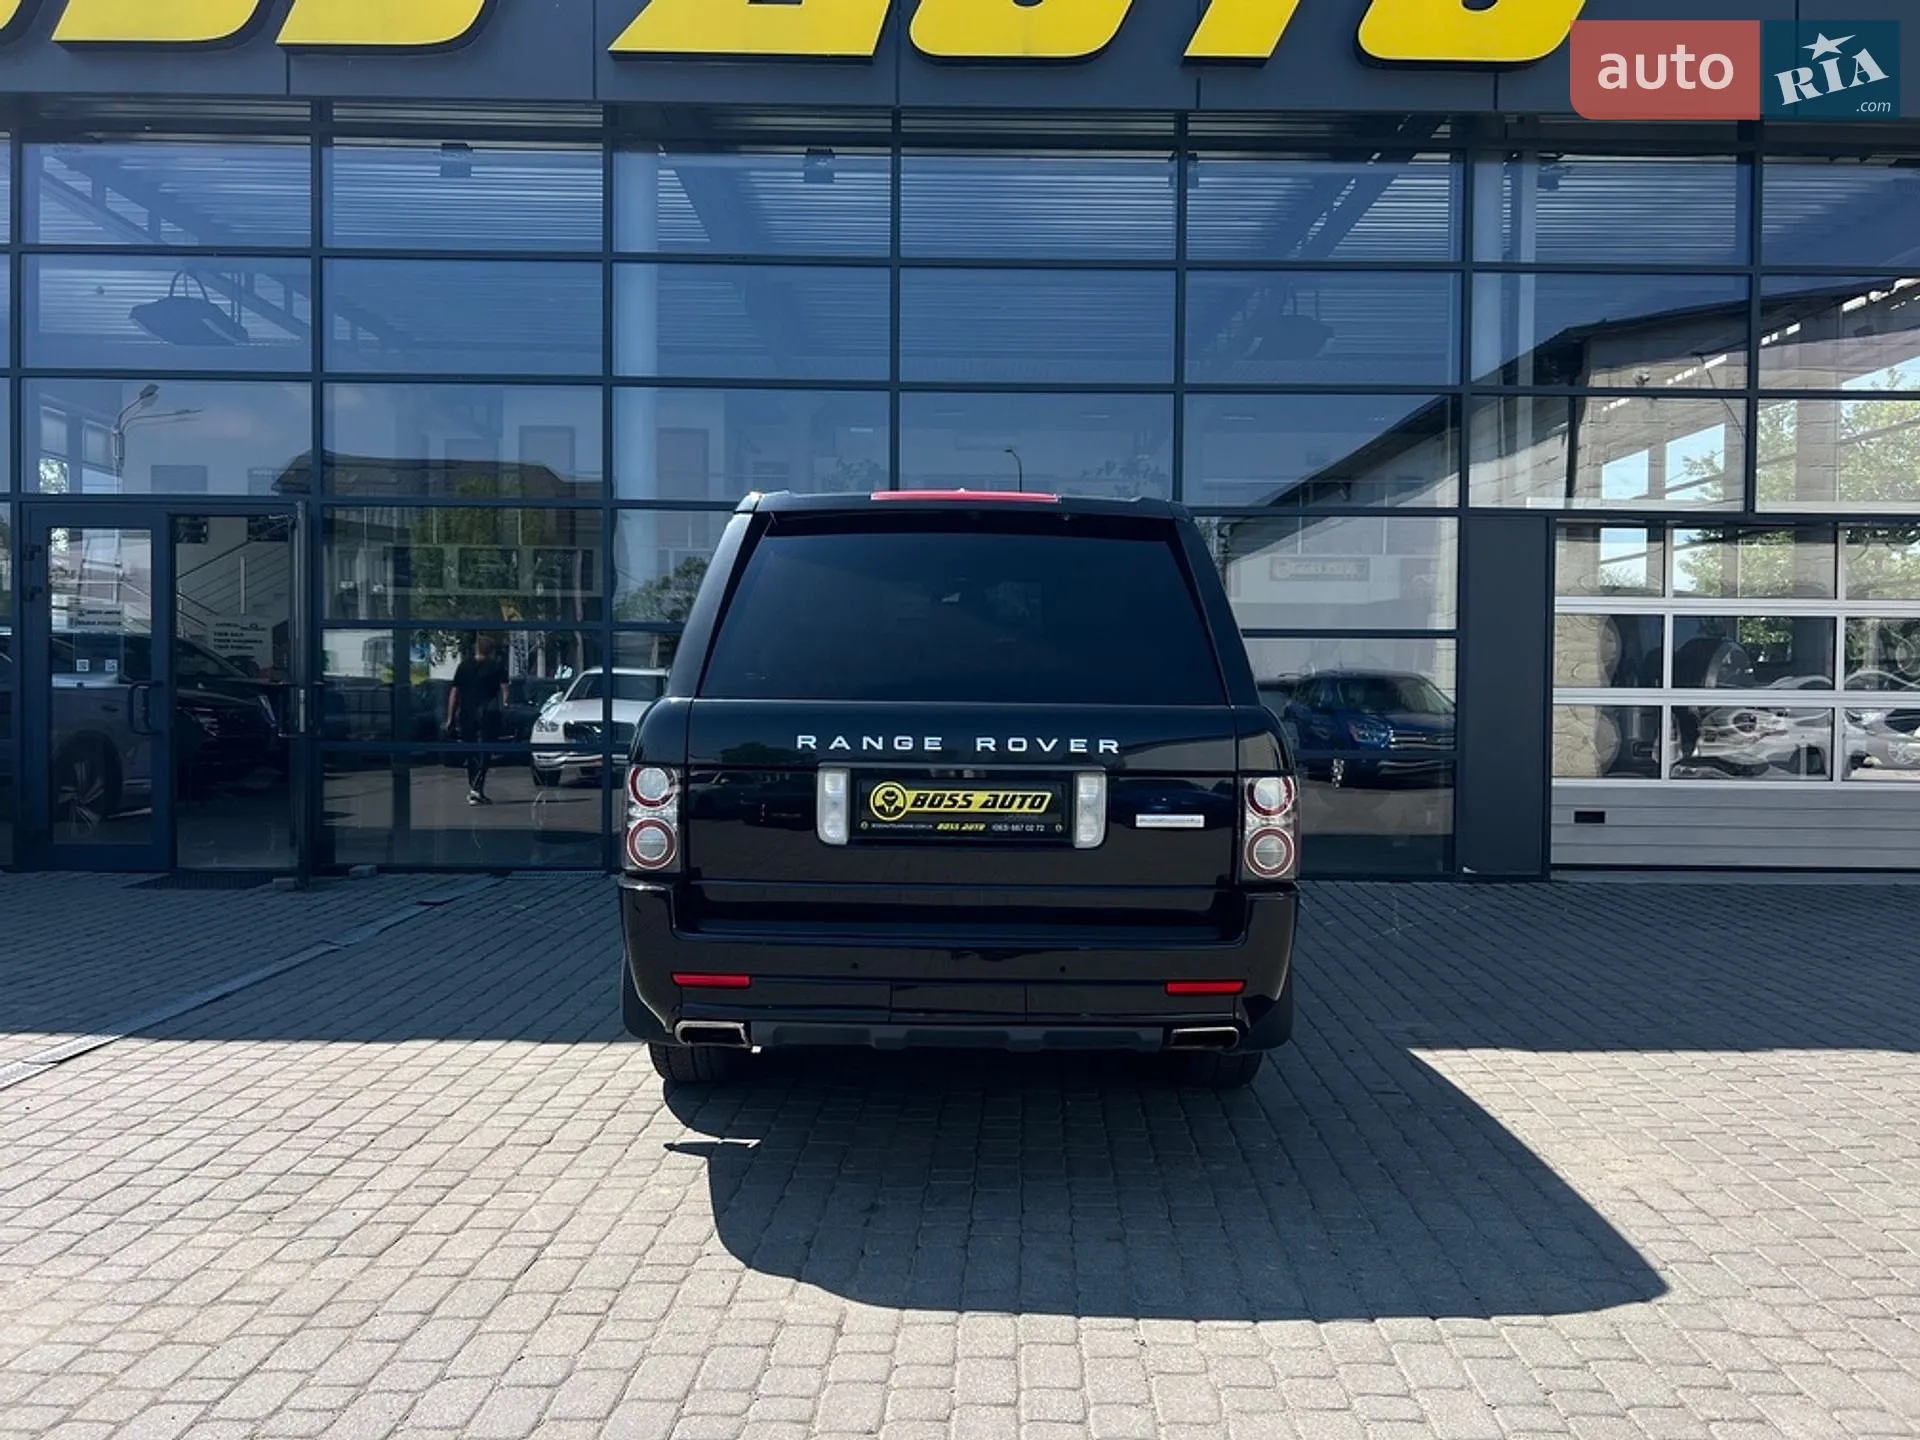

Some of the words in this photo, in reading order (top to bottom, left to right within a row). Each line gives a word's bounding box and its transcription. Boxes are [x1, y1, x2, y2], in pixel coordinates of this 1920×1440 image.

[796, 734, 942, 751] RANGE
[975, 737, 1119, 754] ROVER
[910, 792, 974, 809] BOSS
[979, 793, 1047, 809] AUTO
[936, 822, 960, 831] BOSS
